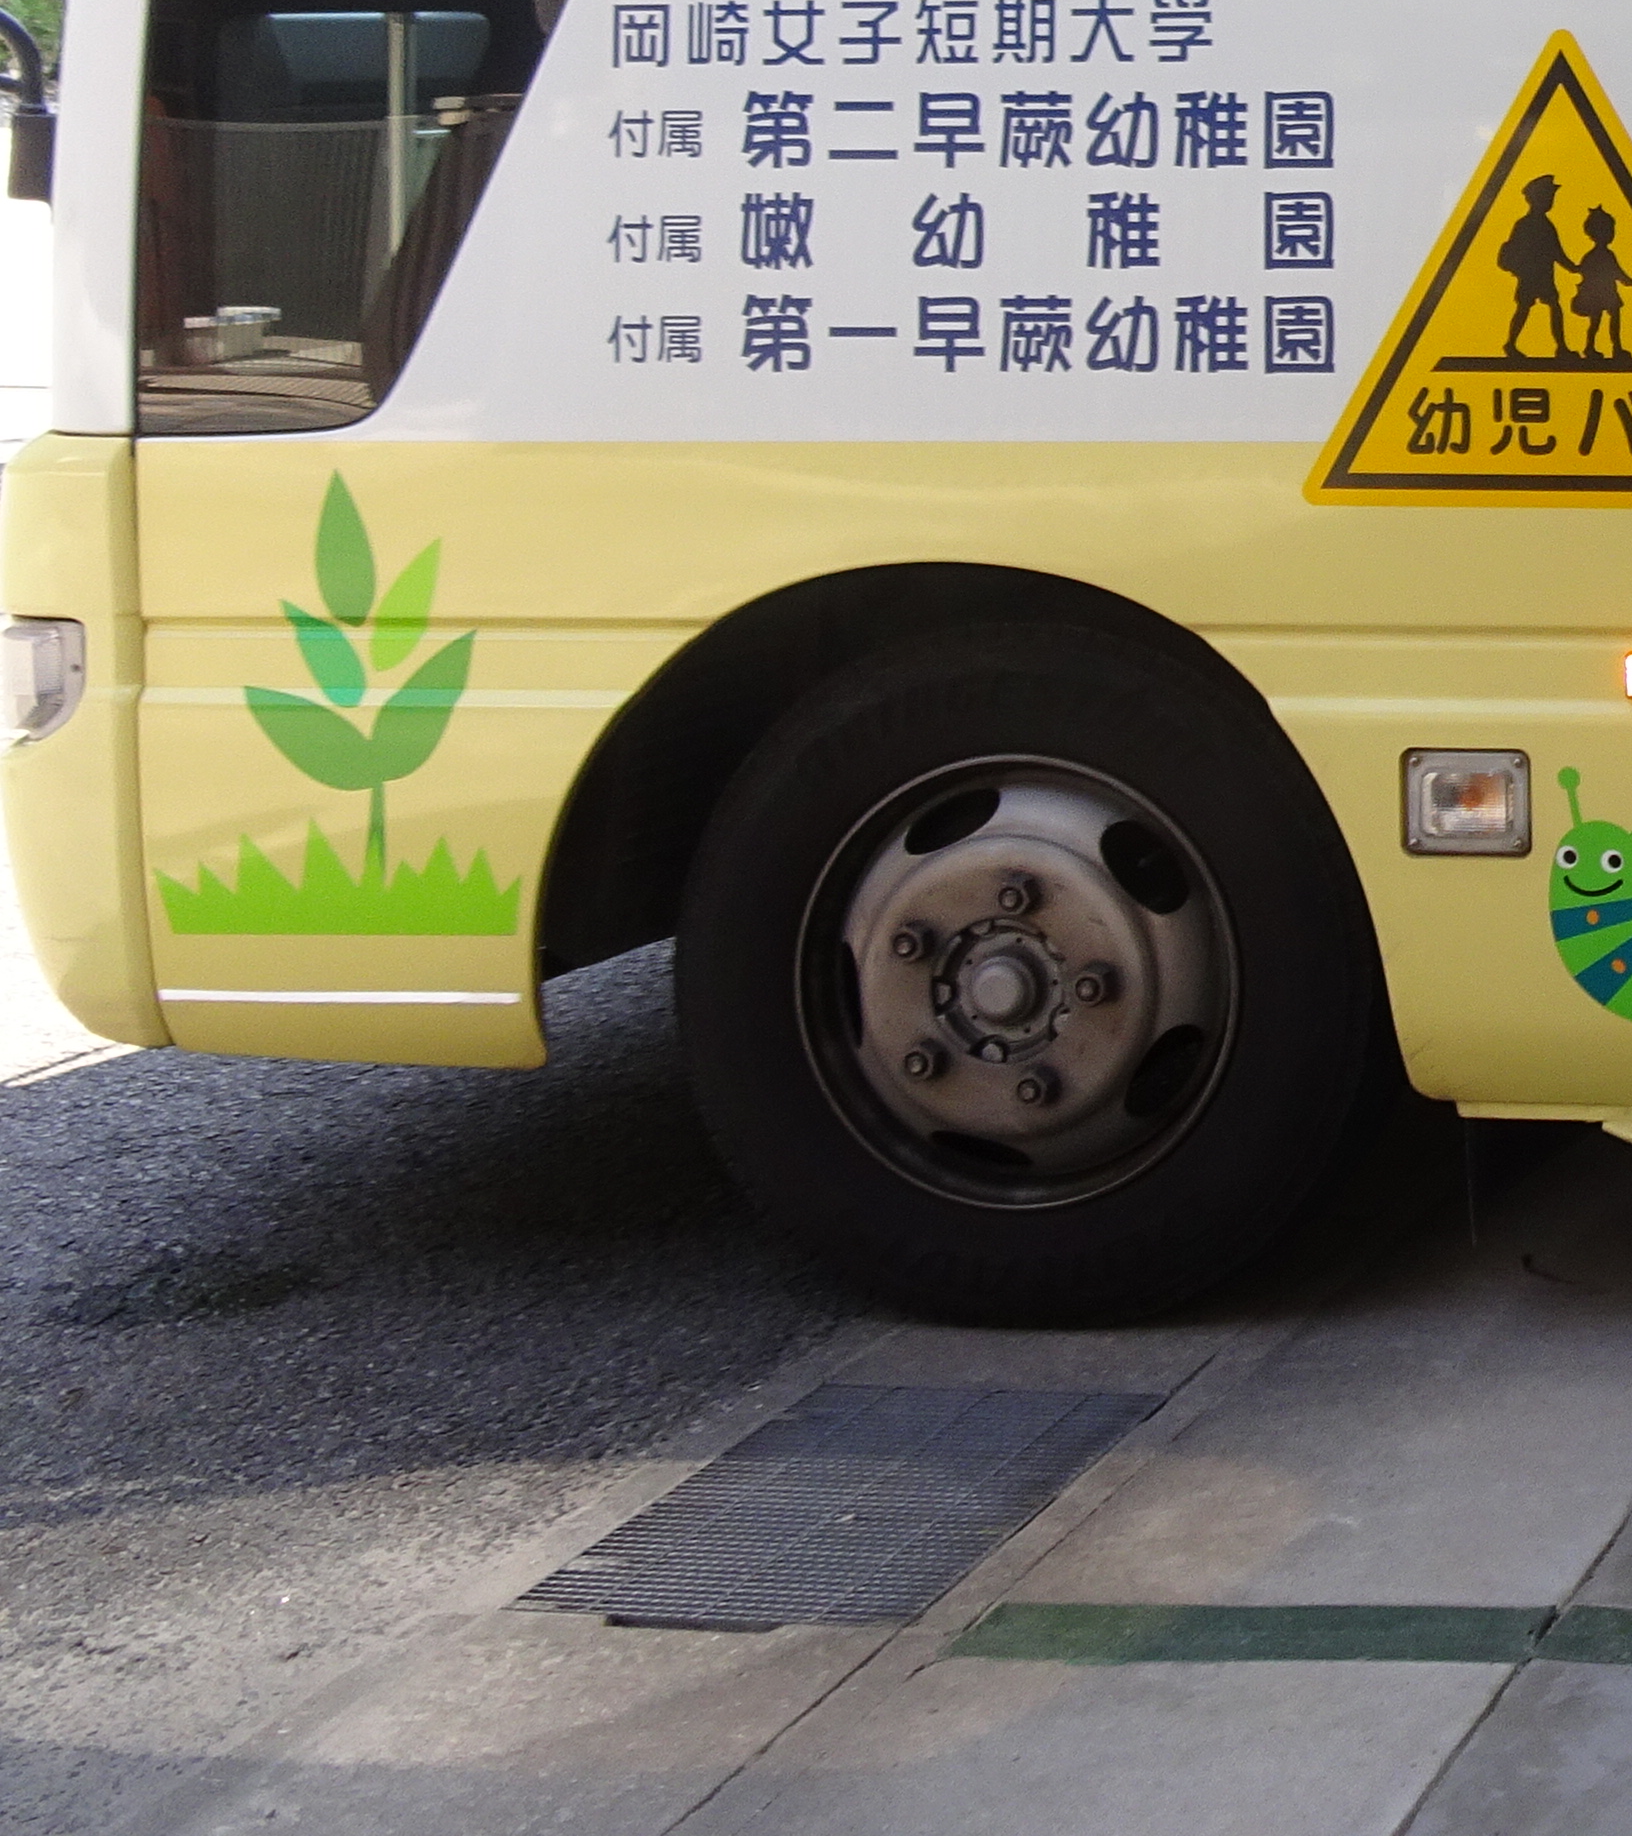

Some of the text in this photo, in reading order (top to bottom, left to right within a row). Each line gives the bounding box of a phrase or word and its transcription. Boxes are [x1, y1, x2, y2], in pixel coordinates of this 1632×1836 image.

[607, 91, 1335, 169] 付属 第二早蕨幼稚園
[607, 214, 703, 263] 付属
[607, 294, 1335, 373] 付属 第一早蕨幼稚園
